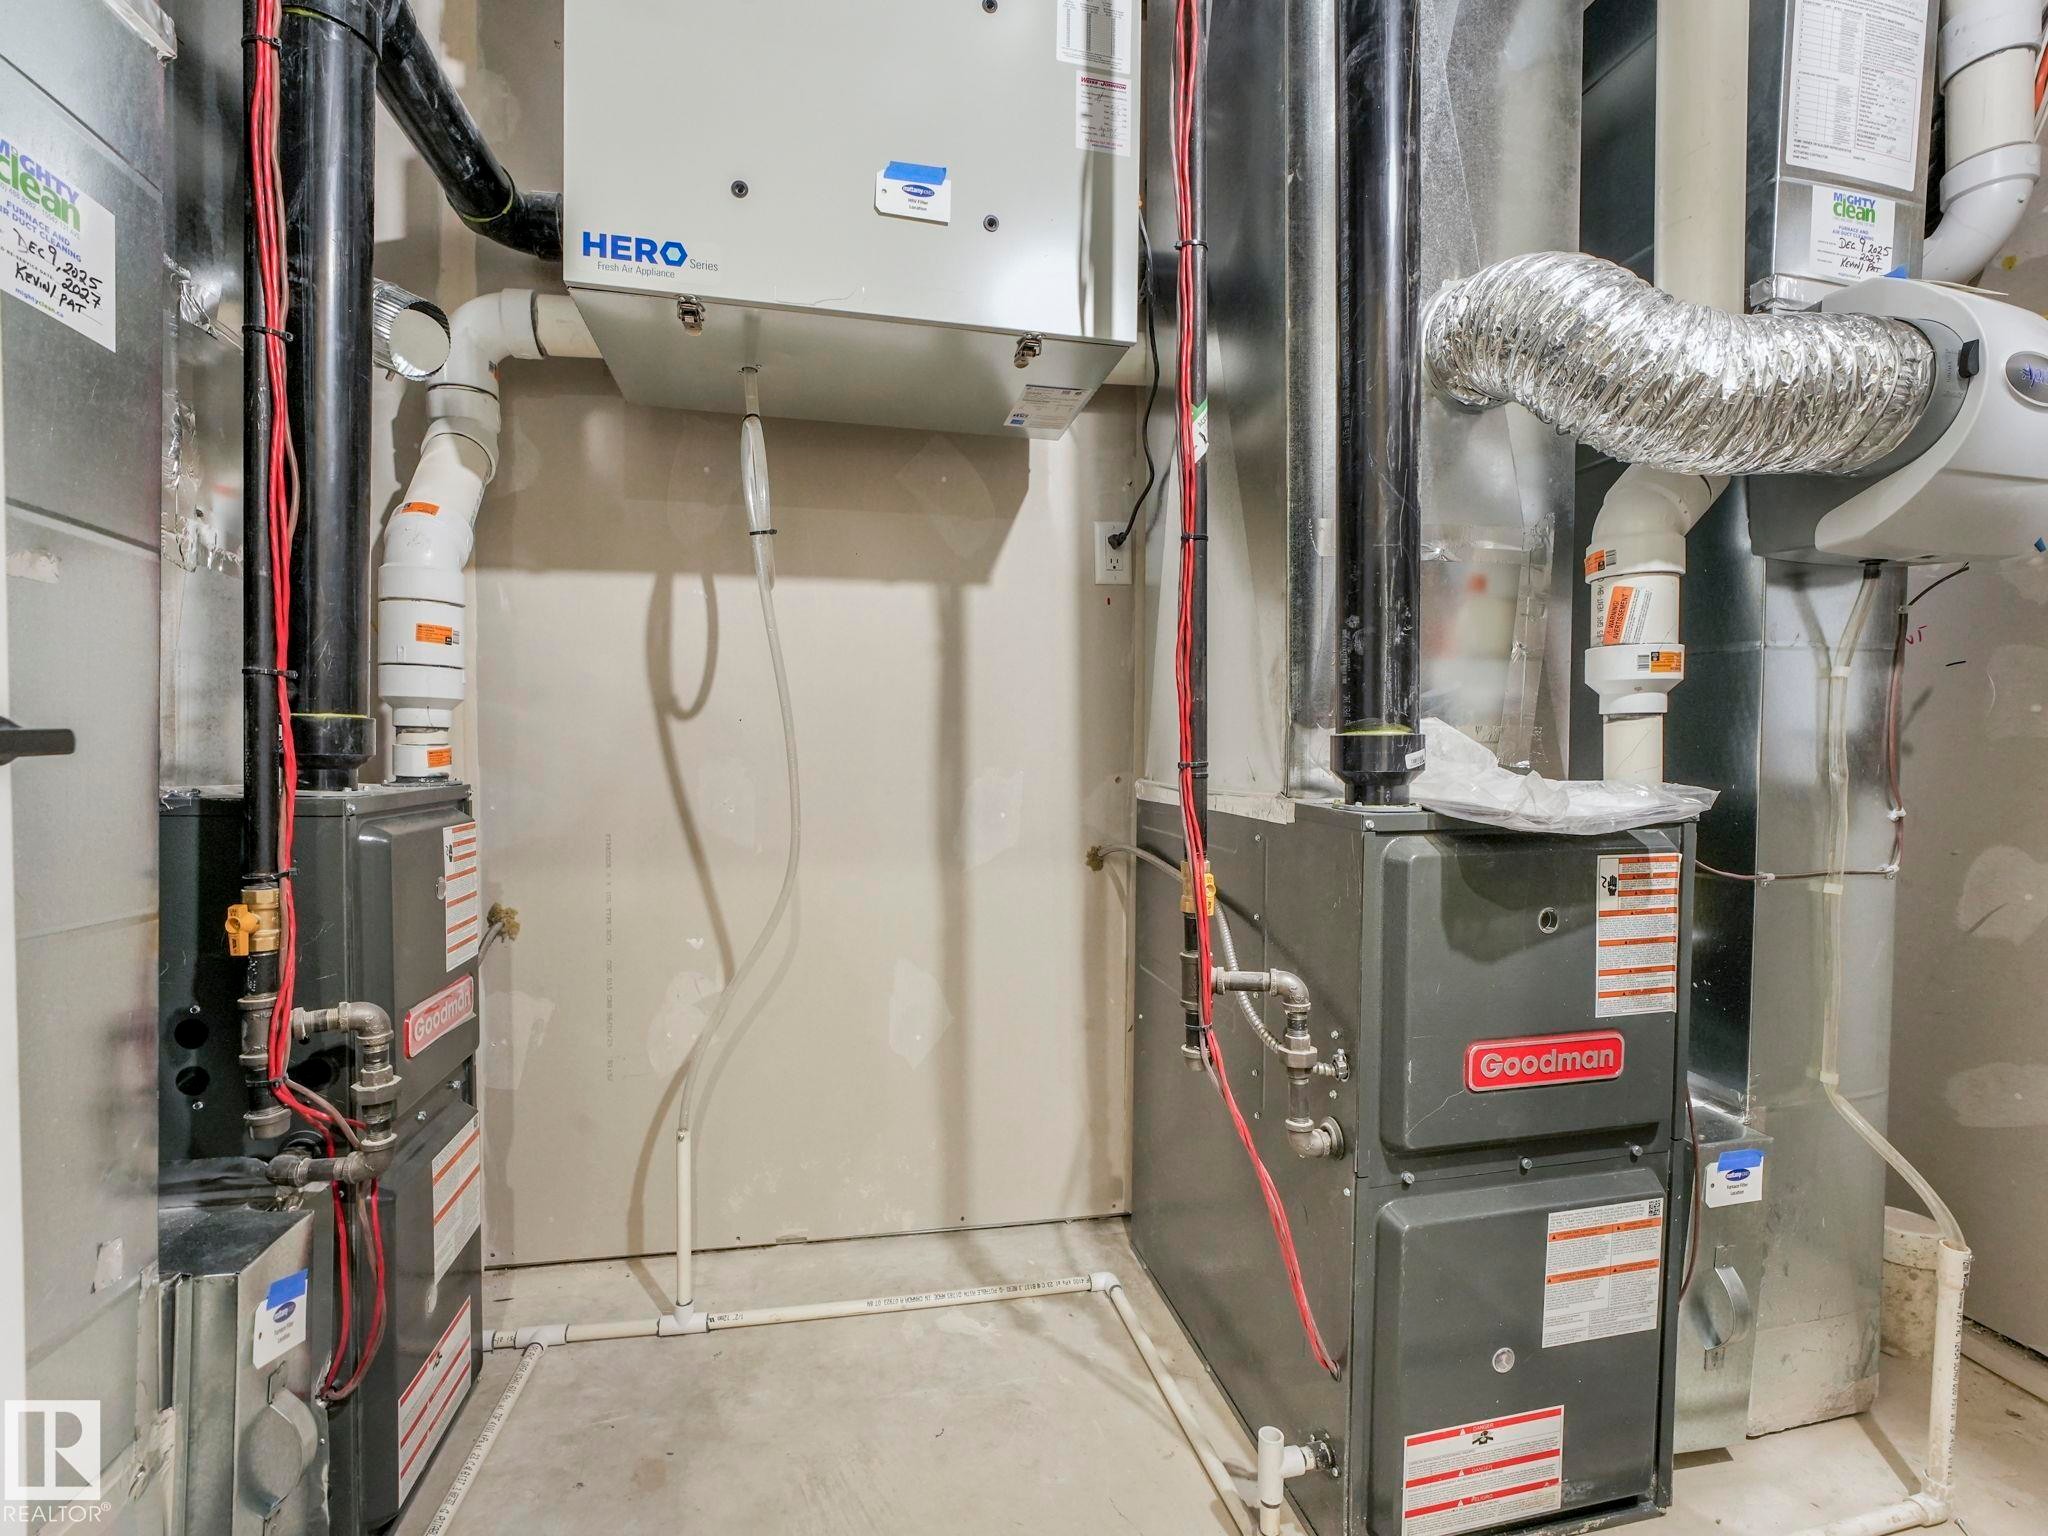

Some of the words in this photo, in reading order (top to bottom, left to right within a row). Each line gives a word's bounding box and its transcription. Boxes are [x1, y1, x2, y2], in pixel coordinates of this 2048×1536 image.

[7, 201, 50, 233] FURNACE
[53, 232, 70, 246] AND
[1833, 199, 1876, 223] clean
[12, 213, 36, 233] DUCT
[40, 231, 82, 262] CLEANING
[582, 232, 688, 267] HERO
[1839, 238, 1856, 250] DEC
[1868, 244, 1892, 256] 2025
[598, 262, 620, 272] Fresh
[622, 264, 633, 273] Air
[636, 266, 676, 278] Appliance
[690, 258, 719, 272] Series
[59, 294, 86, 313] PAT
[62, 278, 101, 309] 2027
[1608, 600, 1620, 628] WARNING
[1613, 594, 1629, 639] AVERTISSEMENT
[414, 991, 470, 1041] Goodman
[1481, 1049, 1614, 1078] Goodman
[1472, 1422, 1494, 1432] DANGER
[1472, 1464, 1493, 1473] DANGER
